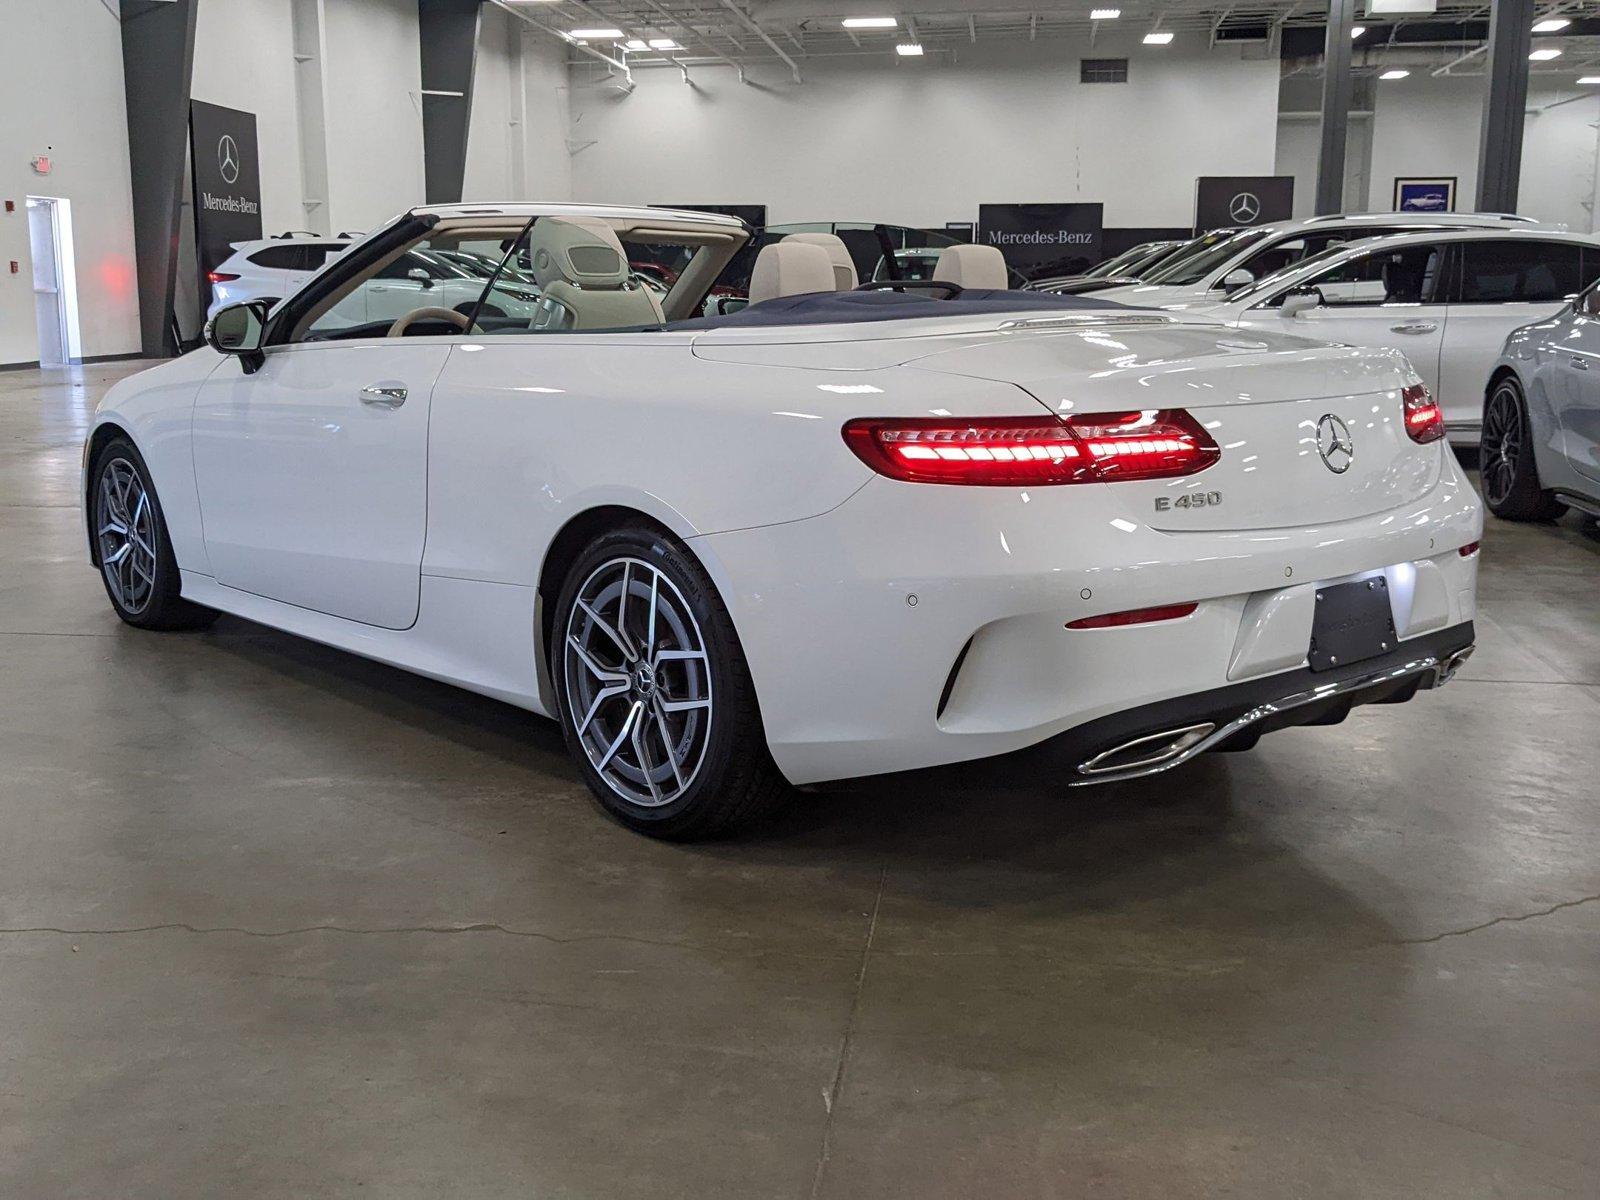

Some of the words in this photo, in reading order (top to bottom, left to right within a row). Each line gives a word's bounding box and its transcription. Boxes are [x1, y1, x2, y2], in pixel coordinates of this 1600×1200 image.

[203, 192, 258, 214] Mercedes-Benz
[988, 230, 1092, 244] Mercedes-Benz
[1155, 497, 1171, 512] E
[1173, 491, 1223, 510] 450
